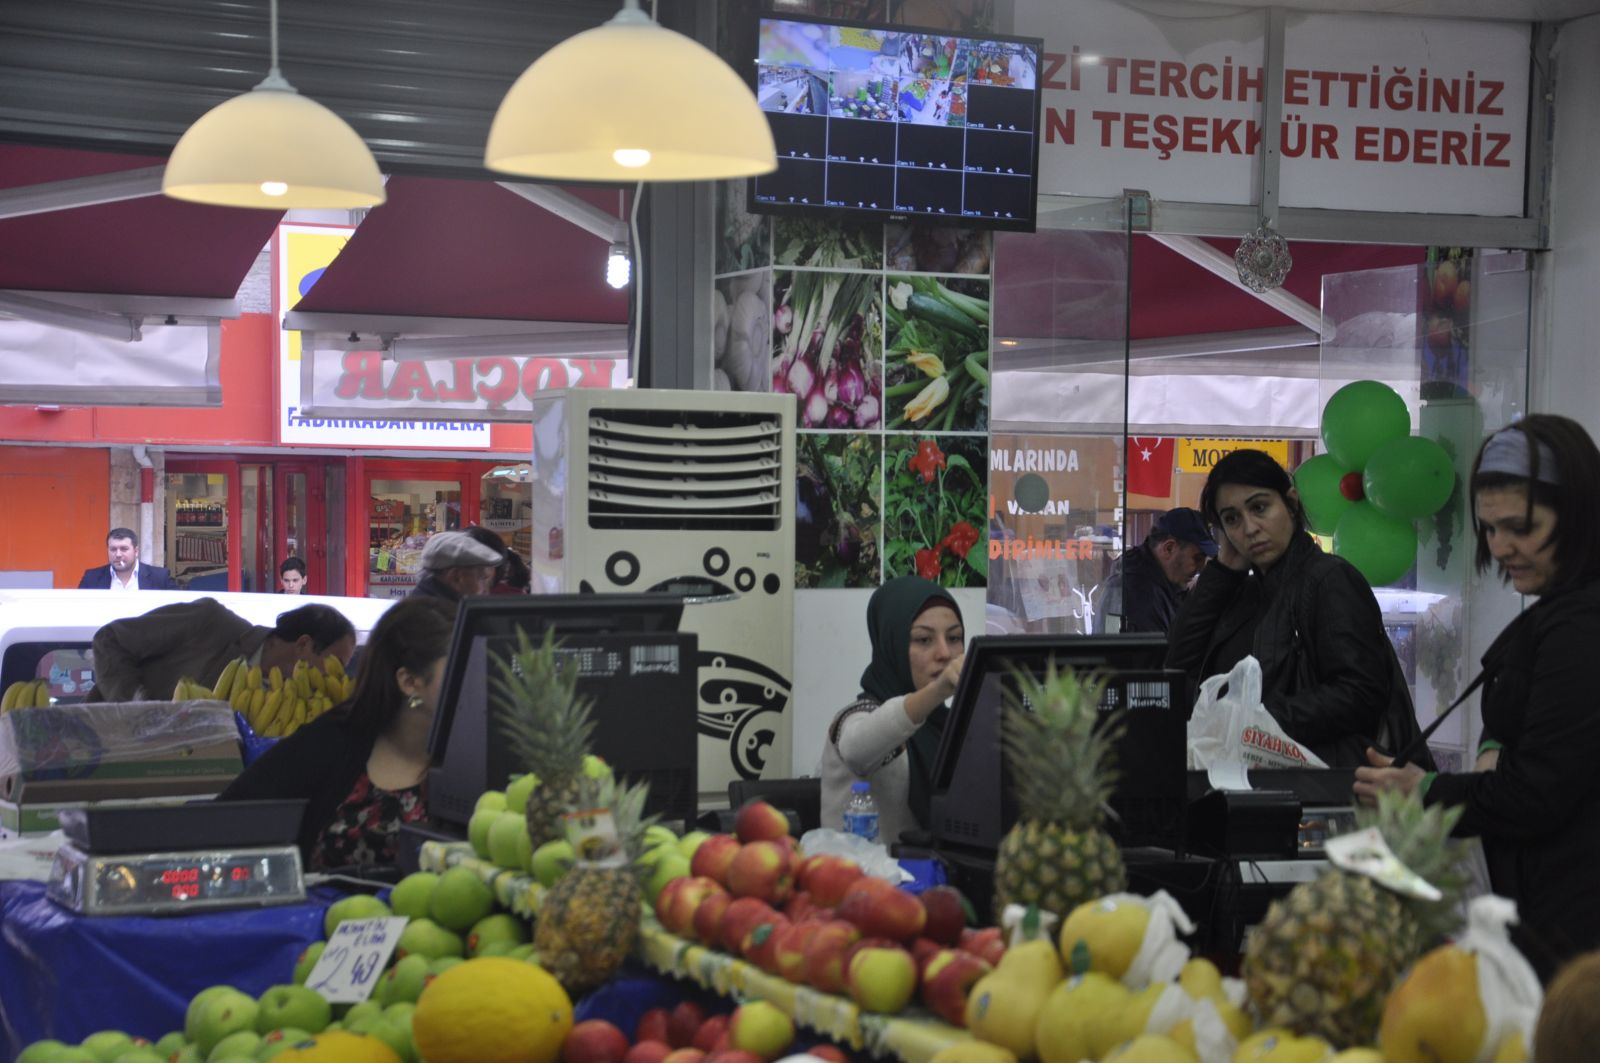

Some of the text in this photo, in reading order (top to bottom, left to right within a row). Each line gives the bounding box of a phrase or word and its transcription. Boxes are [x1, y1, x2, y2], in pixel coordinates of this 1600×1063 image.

[1101, 55, 1263, 102] TERCİH
[1284, 64, 1505, 116] ETTİĞİNİZ
[1045, 108, 1512, 168] N TEŞEKKÜR EDERİZ
[990, 449, 1079, 472] MLARINDA
[1007, 499, 1070, 516] VAN
